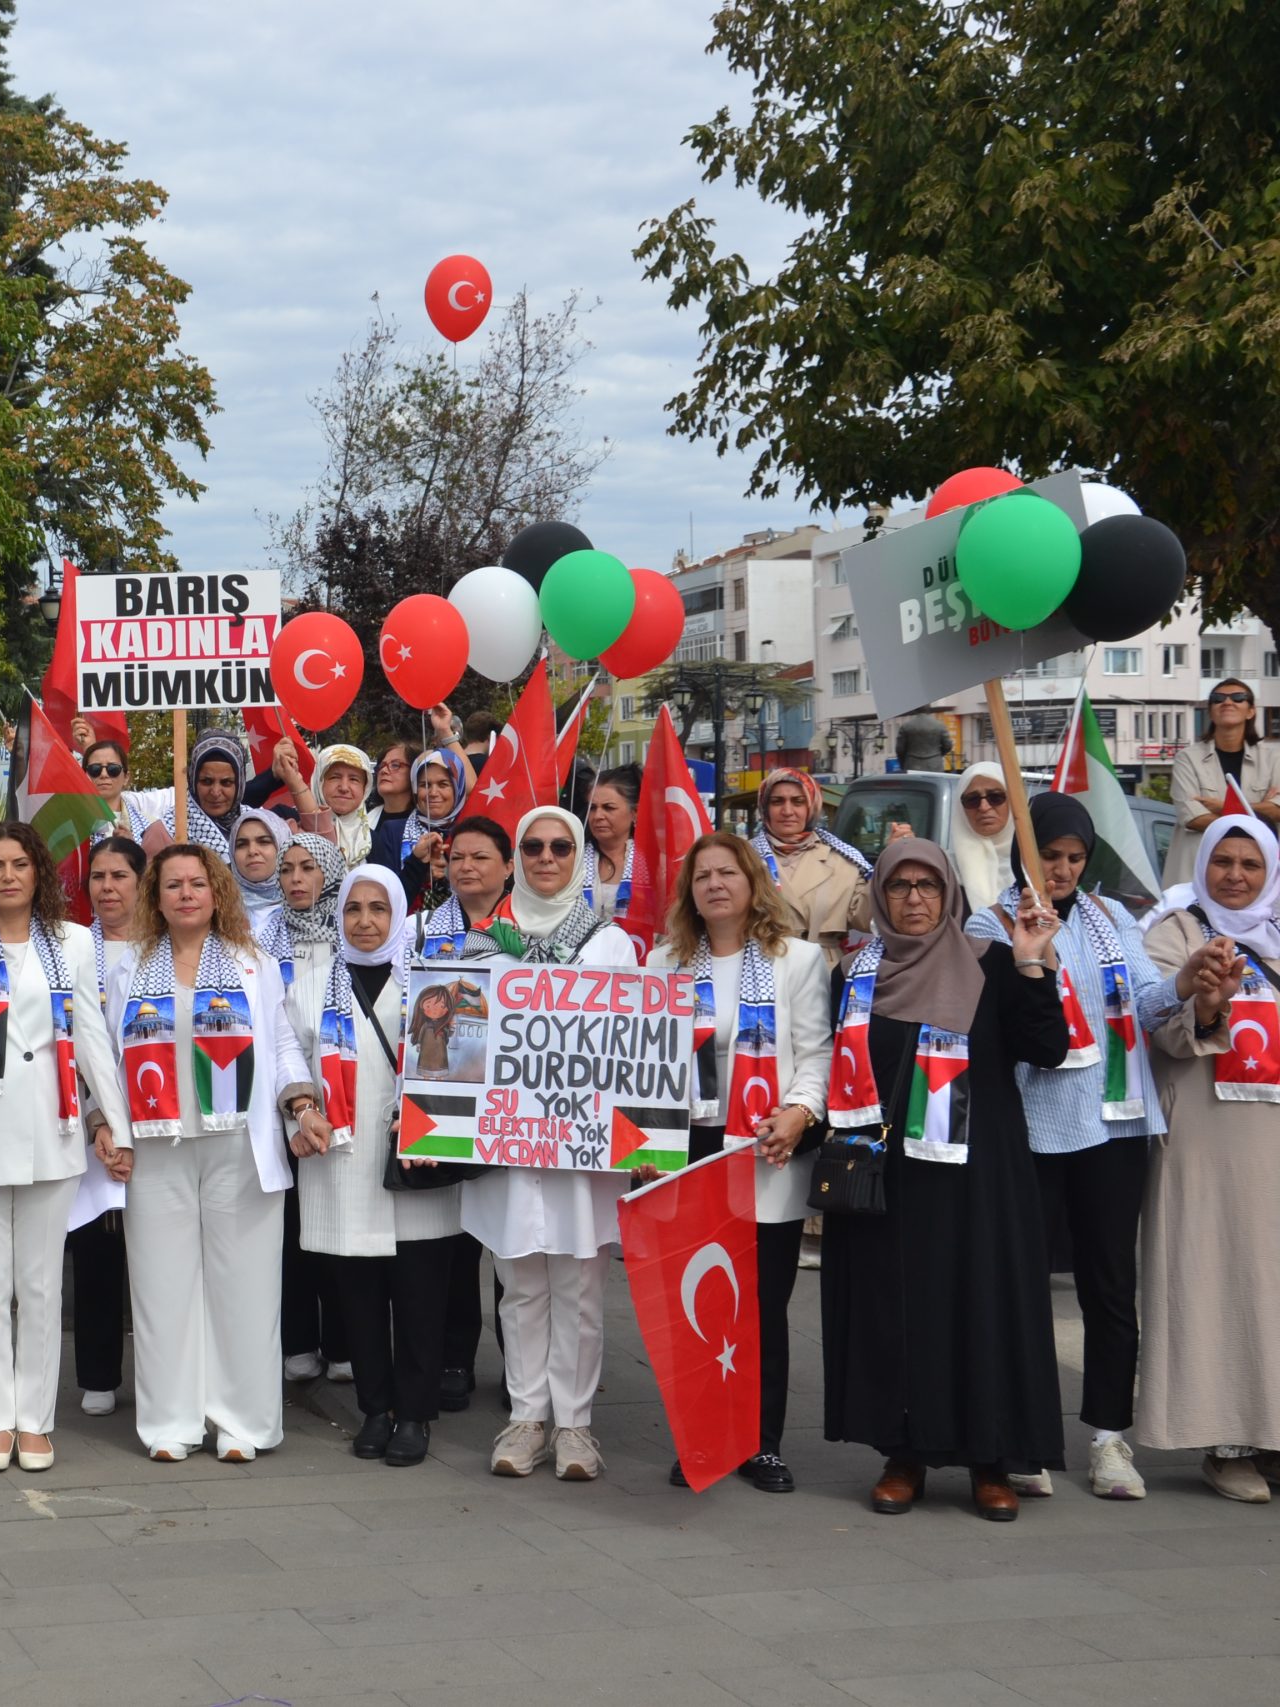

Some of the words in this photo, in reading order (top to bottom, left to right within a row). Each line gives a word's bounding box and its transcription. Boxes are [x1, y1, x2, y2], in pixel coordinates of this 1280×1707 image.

[115, 574, 249, 627] BARIŞ
[90, 617, 269, 660] KADINLA
[82, 660, 275, 708] MÜMKÜN
[497, 969, 694, 1016] GAZZE'DE
[499, 1013, 678, 1063] SOYKIRIMI
[493, 1051, 687, 1102] DURDURUN
[485, 1089, 519, 1116] SU
[475, 1135, 559, 1169] VİCDAN
[565, 1144, 606, 1170] YOK
[478, 1115, 573, 1142] ELEKTRİK
[575, 1122, 609, 1146] YOK
